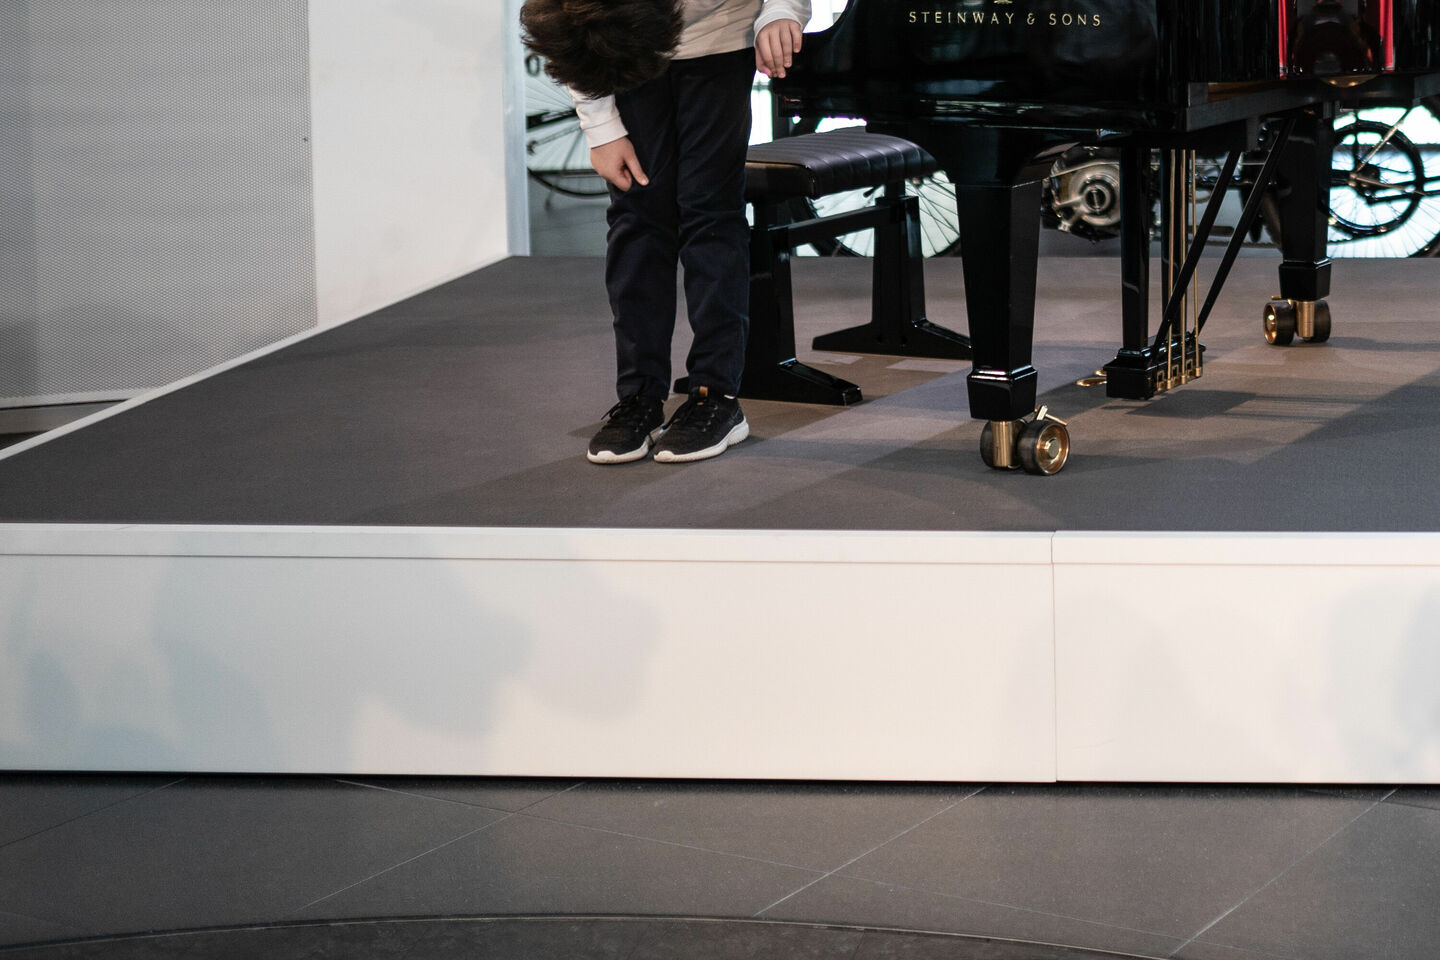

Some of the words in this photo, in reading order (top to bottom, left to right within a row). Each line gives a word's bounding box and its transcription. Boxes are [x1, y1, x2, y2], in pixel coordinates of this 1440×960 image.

[909, 11, 1014, 25] STEINWAY
[1026, 12, 1036, 26] &
[1048, 13, 1102, 27] SONS
